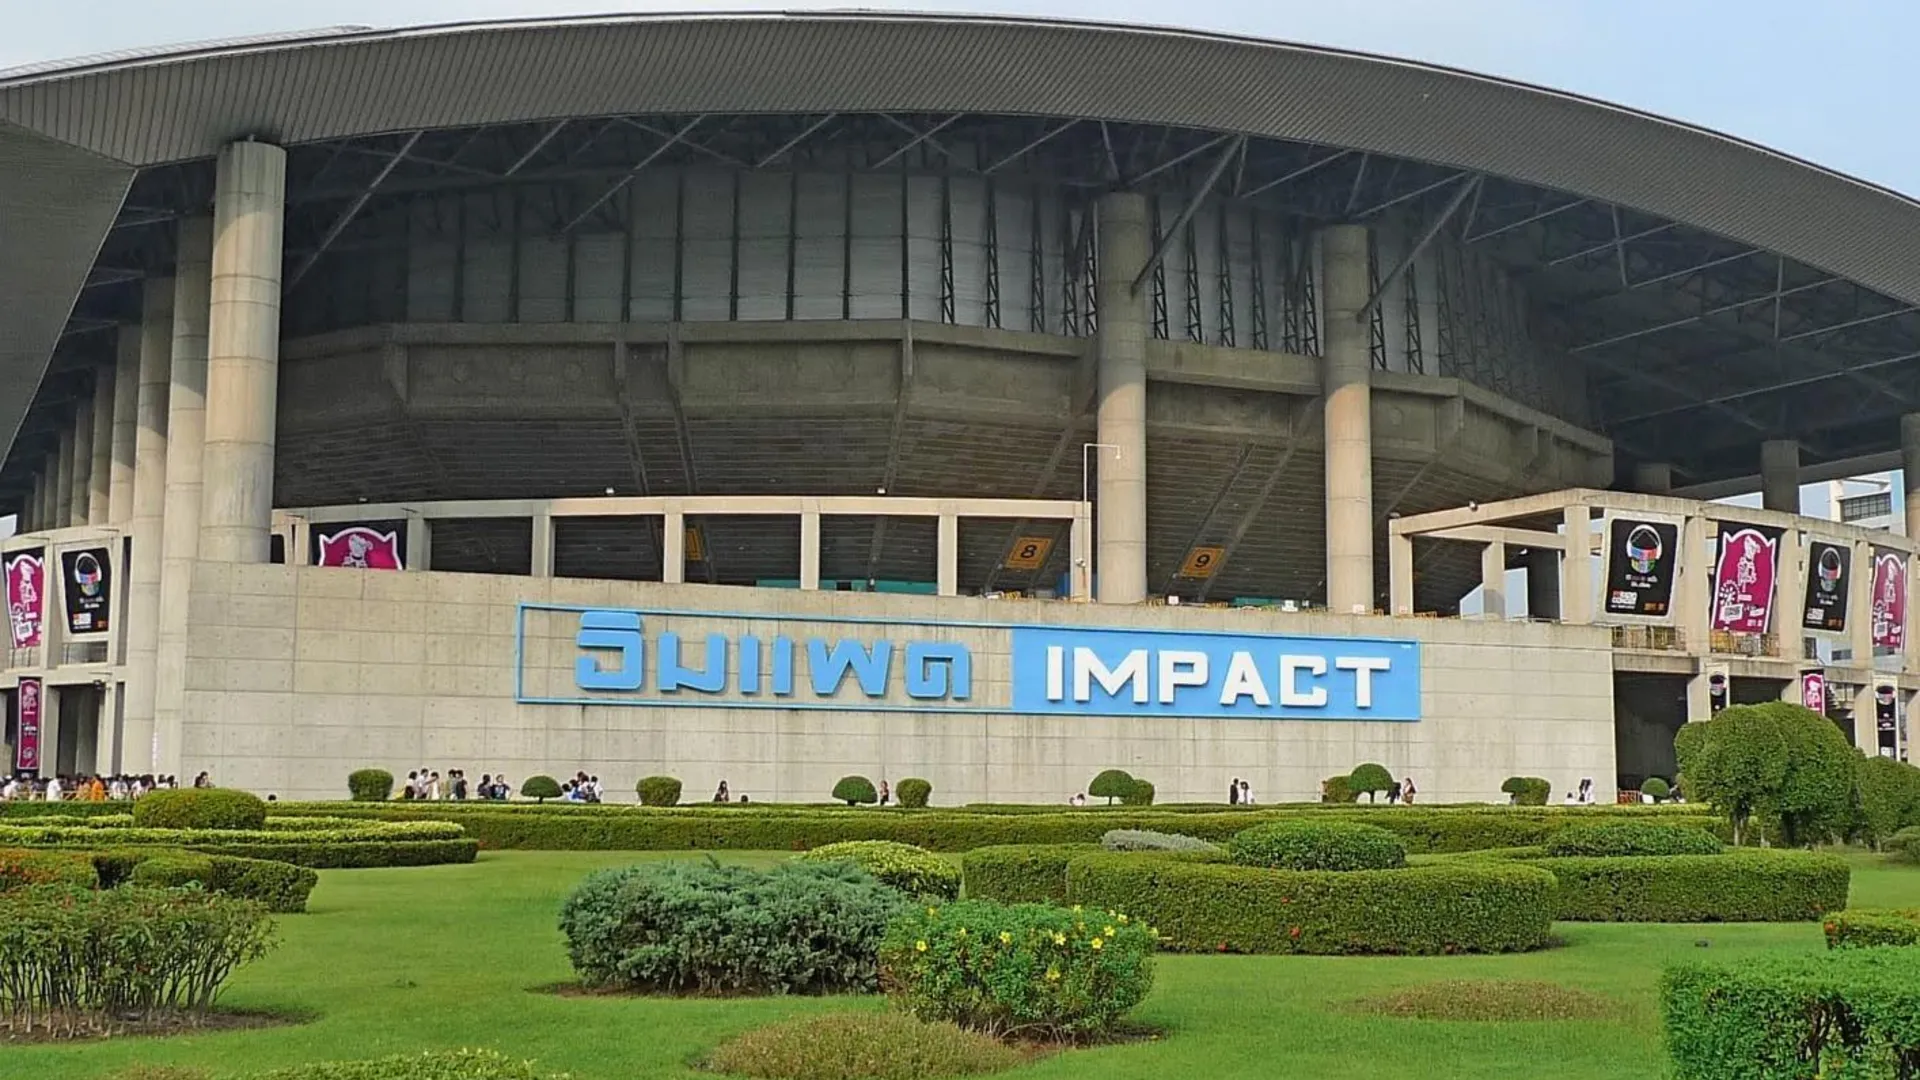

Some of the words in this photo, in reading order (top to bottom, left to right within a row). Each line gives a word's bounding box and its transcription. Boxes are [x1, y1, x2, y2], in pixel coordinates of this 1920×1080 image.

[1020, 544, 1037, 559] 8
[1194, 553, 1211, 569] 9
[1046, 646, 1391, 708] IMPACT
